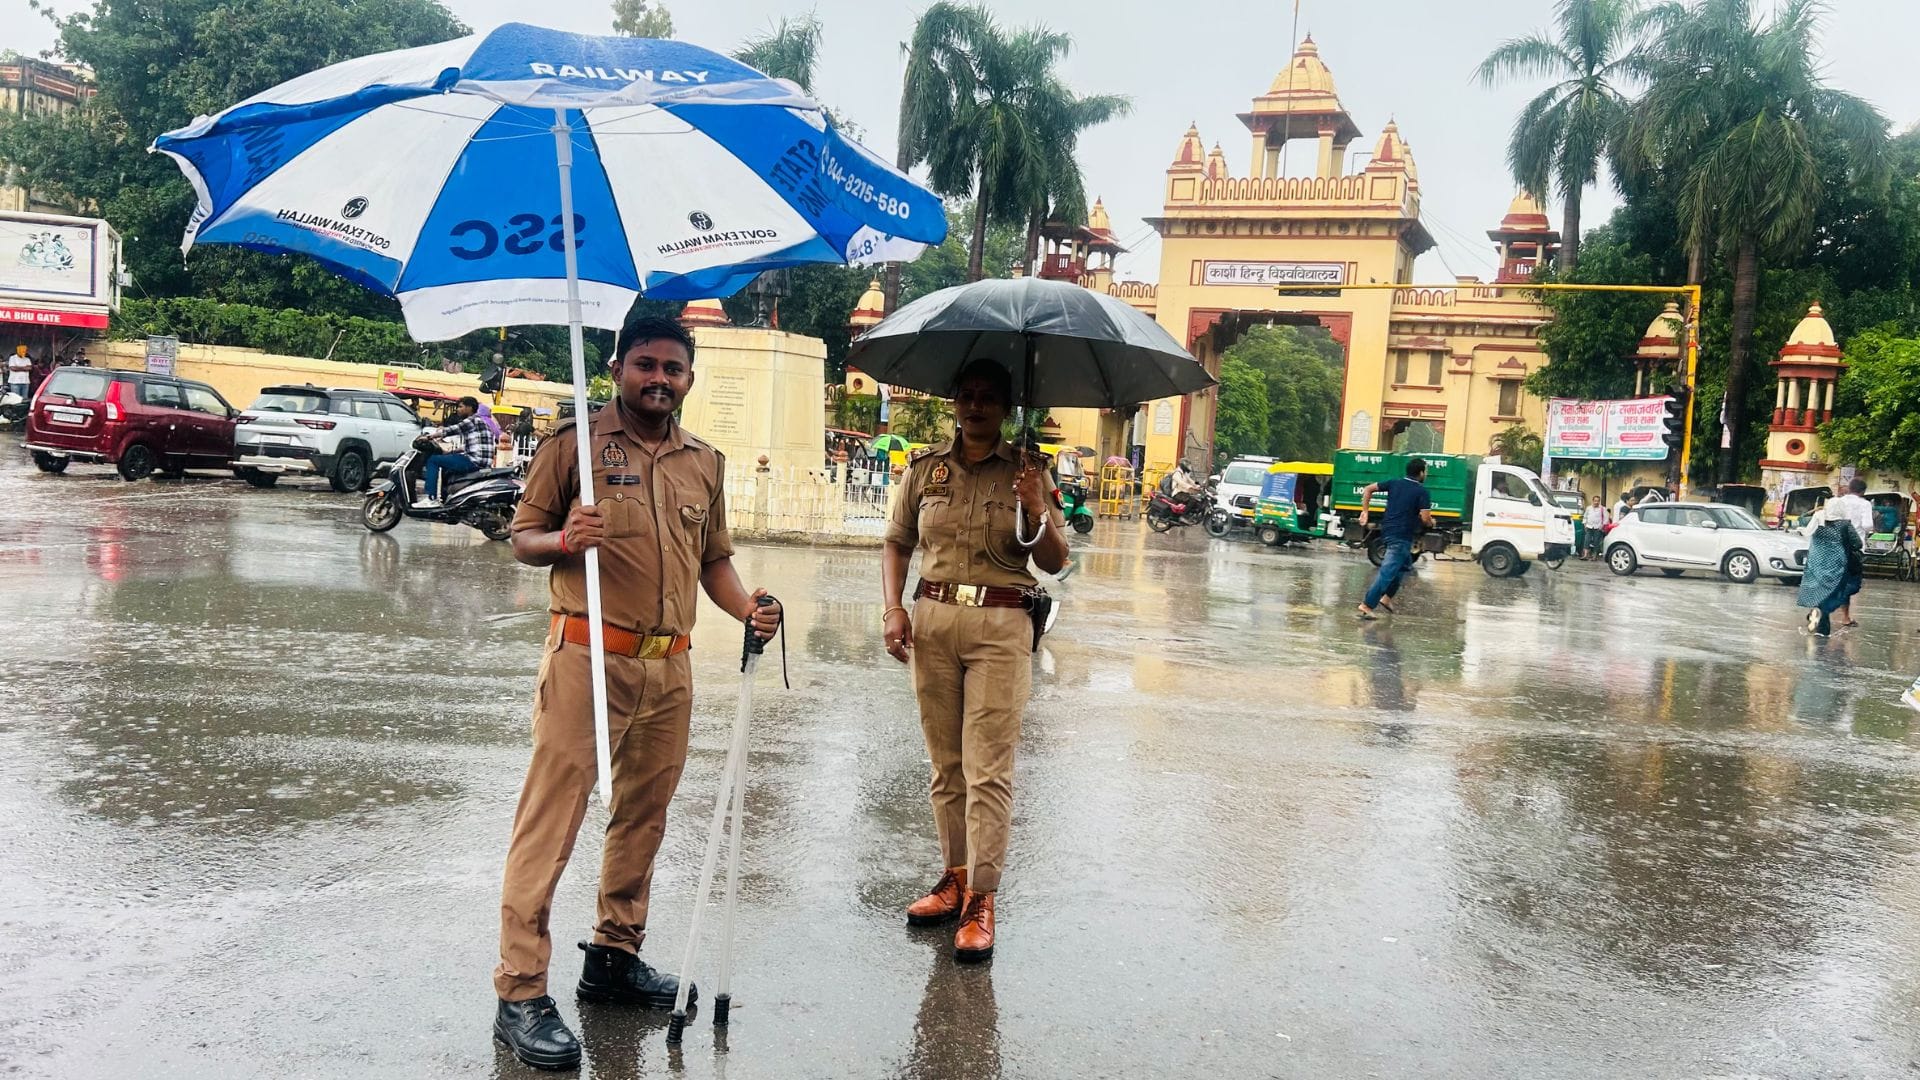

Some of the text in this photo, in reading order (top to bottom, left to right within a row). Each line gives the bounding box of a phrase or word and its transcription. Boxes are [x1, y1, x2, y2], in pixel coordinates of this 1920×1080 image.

[529, 62, 709, 83] RAILWAY
[827, 156, 910, 219] 844-8215-580
[1209, 265, 1339, 282] काशी हिन्दू विश्वविद्यालय
[14, 311, 34, 321] BHU
[37, 313, 61, 323] GATE
[1620, 400, 1664, 415] समाजवादी
